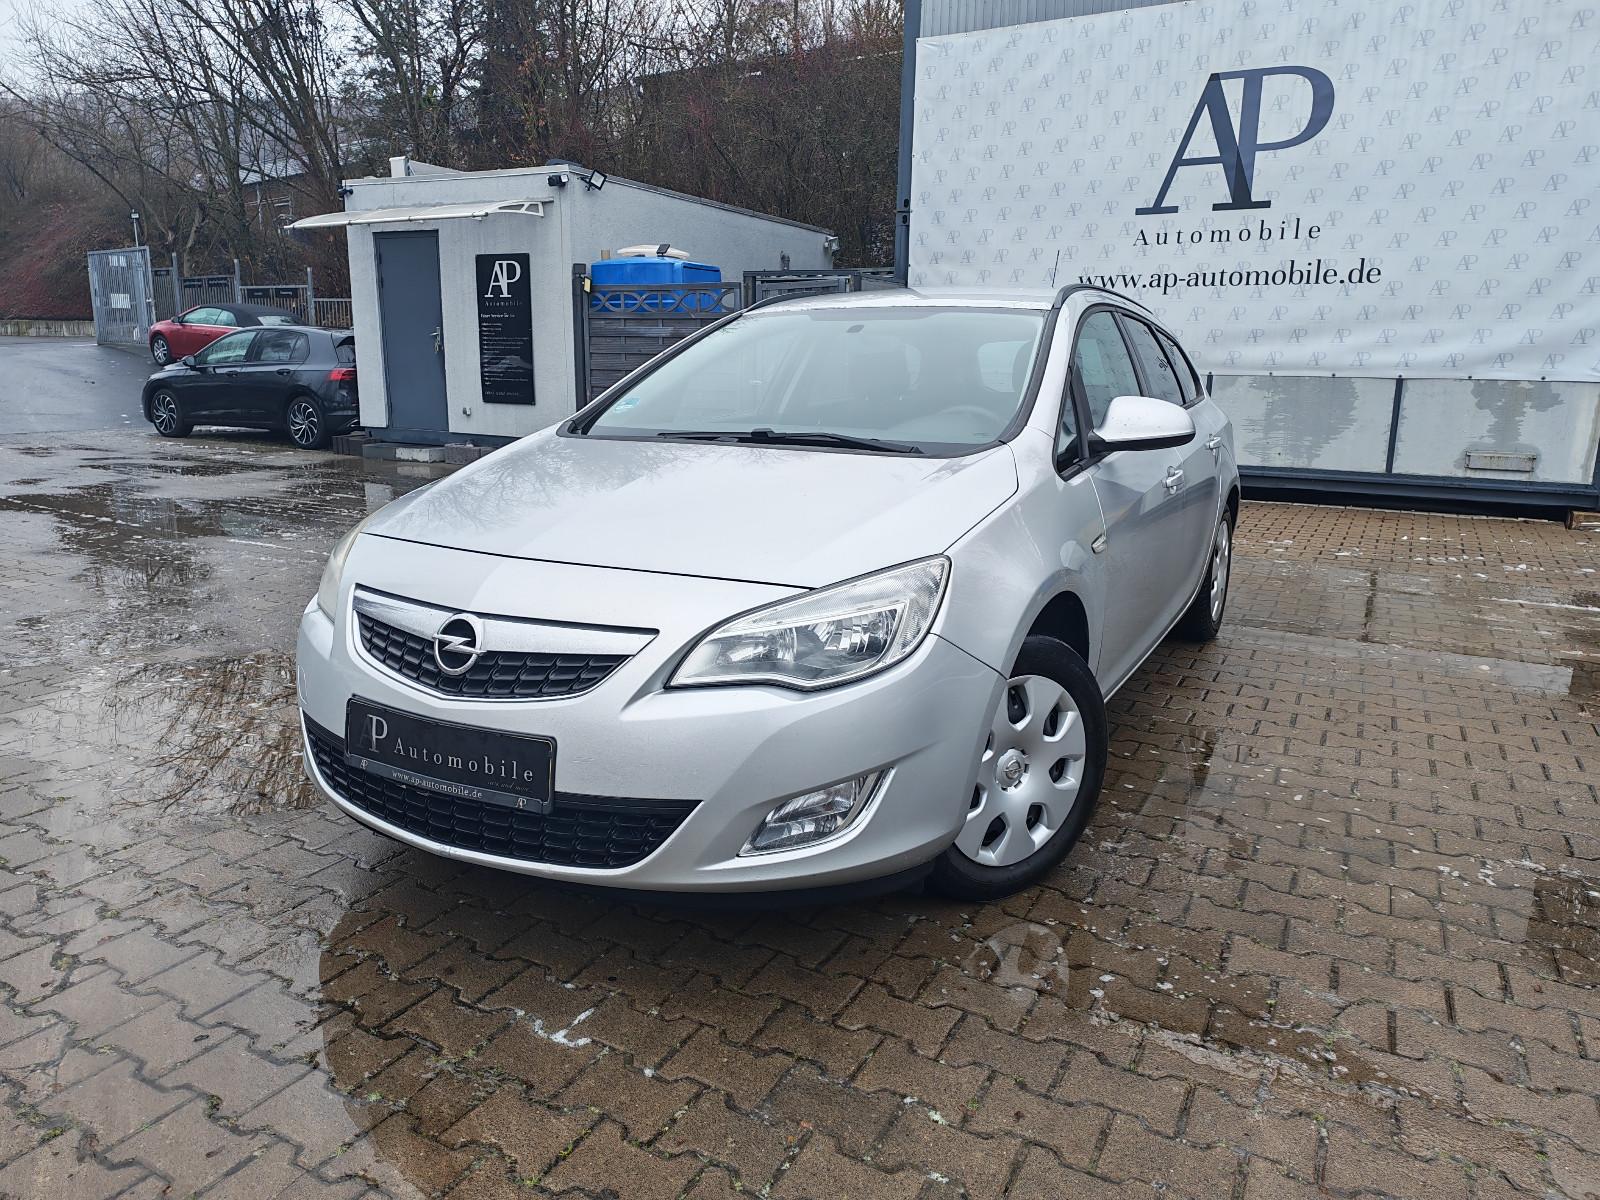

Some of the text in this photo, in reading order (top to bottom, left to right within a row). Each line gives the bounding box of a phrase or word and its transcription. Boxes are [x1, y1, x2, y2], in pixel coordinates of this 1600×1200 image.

[1194, 7, 1213, 23] AP
[1236, 1, 1256, 17] AP
[1391, 6, 1414, 23] AP
[1440, 0, 1464, 17] AP
[1154, 12, 1172, 28] AP
[1298, 18, 1319, 34] AP
[1344, 12, 1366, 29] AP
[1513, 17, 1539, 35] AP
[1568, 9, 1594, 28] AP
[1077, 23, 1094, 38] AP
[1212, 28, 1232, 44] AP
[1254, 24, 1275, 40] AP
[1461, 24, 1486, 41] AP
[1006, 33, 1022, 48] AP
[1172, 34, 1190, 49] AP
[1364, 35, 1386, 52] AP
[1412, 30, 1435, 47] AP
[1132, 39, 1150, 54] AP
[1274, 45, 1294, 61] AP
[1318, 40, 1340, 56] AP
[1536, 41, 1561, 59] AP
[1057, 48, 1074, 63] AP
[1190, 55, 1209, 70] AP
[1231, 50, 1251, 66] AP
[1433, 53, 1457, 70] AP
[1483, 48, 1508, 65] AP
[987, 57, 1003, 71] AP
[1112, 64, 1129, 79] AP
[1150, 60, 1168, 75] AP
[1338, 63, 1360, 80] AP
[1384, 59, 1407, 75] AP
[1038, 73, 1054, 88] AP
[1505, 72, 1530, 89] AP
[1558, 66, 1584, 84] AP
[1129, 86, 1146, 100] AP
[1168, 81, 1186, 96] AP
[1405, 82, 1428, 98] AP
[1454, 77, 1478, 94] AP
[1091, 90, 1108, 104] AP
[1358, 86, 1380, 102] AP
[1019, 98, 1035, 111] AP
[1475, 101, 1500, 118] AP
[1527, 96, 1553, 113] AP
[1071, 114, 1088, 128] AP
[1146, 107, 1164, 121] AP
[1378, 110, 1401, 126] AP
[1426, 106, 1450, 122] AP
[1447, 129, 1471, 145] AP
[1497, 125, 1522, 142] AP
[1550, 121, 1576, 138] AP
[1051, 138, 1068, 152] AP
[1125, 132, 1143, 146] AP
[1135, 65, 1335, 215] AP
[1352, 137, 1374, 152] AP
[1398, 133, 1421, 149] AP
[1068, 159, 1084, 172] AP
[1105, 156, 1122, 170] AP
[1419, 157, 1442, 172] AP
[1468, 153, 1492, 169] AP
[1520, 150, 1545, 166] AP
[1283, 166, 1304, 180] AP
[1327, 163, 1348, 178] AP
[1372, 160, 1395, 175] AP
[1084, 180, 1101, 193] AP
[1122, 177, 1139, 191] AP
[1440, 181, 1464, 196] AP
[1490, 178, 1514, 194] AP
[1542, 174, 1567, 191] AP
[1302, 188, 1323, 203] AP
[1347, 186, 1368, 201] AP
[1393, 183, 1415, 198] AP
[1101, 201, 1118, 214] AP
[1413, 207, 1436, 222] AP
[1461, 205, 1485, 220] AP
[1512, 202, 1536, 218] AP
[1564, 199, 1590, 215] AP
[1322, 211, 1343, 226] AP
[1366, 209, 1388, 224] AP
[1133, 217, 1321, 247] Automobile
[1434, 231, 1457, 246] AP
[1483, 229, 1507, 244] AP
[1534, 227, 1559, 242] AP
[1341, 234, 1363, 249] AP
[1387, 233, 1409, 247] AP
[1407, 256, 1430, 271] AP
[1454, 255, 1478, 270] AP
[1504, 254, 1529, 269] AP
[1556, 252, 1582, 267] AP
[484, 260, 521, 298] AP
[1078, 257, 1382, 295] www.ap-automobile.de
[1428, 280, 1450, 295] AP
[1476, 279, 1500, 294] AP
[1526, 278, 1551, 293] AP
[1186, 307, 1205, 320] AP
[1226, 307, 1246, 320] AP
[1268, 306, 1288, 319] AP
[1311, 306, 1332, 320] AP
[1355, 305, 1377, 319] AP
[1401, 305, 1423, 319] AP
[1448, 304, 1471, 318] AP
[1497, 304, 1521, 318] AP
[1548, 303, 1574, 318] AP
[1204, 329, 1223, 342] AP
[1245, 329, 1264, 342] AP
[1287, 328, 1307, 342] AP
[1330, 328, 1351, 342] AP
[1375, 329, 1397, 343] AP
[1421, 329, 1444, 343] AP
[1469, 328, 1492, 343] AP
[1519, 328, 1543, 343] AP
[1570, 328, 1596, 343] AP
[1306, 352, 1326, 365] AP
[1349, 352, 1371, 365] AP
[1442, 353, 1465, 367] AP
[1490, 352, 1514, 367] AP
[1540, 353, 1565, 367] AP
[393, 737, 533, 782] Automobile
[392, 769, 483, 799] www.ap-automobile.de
